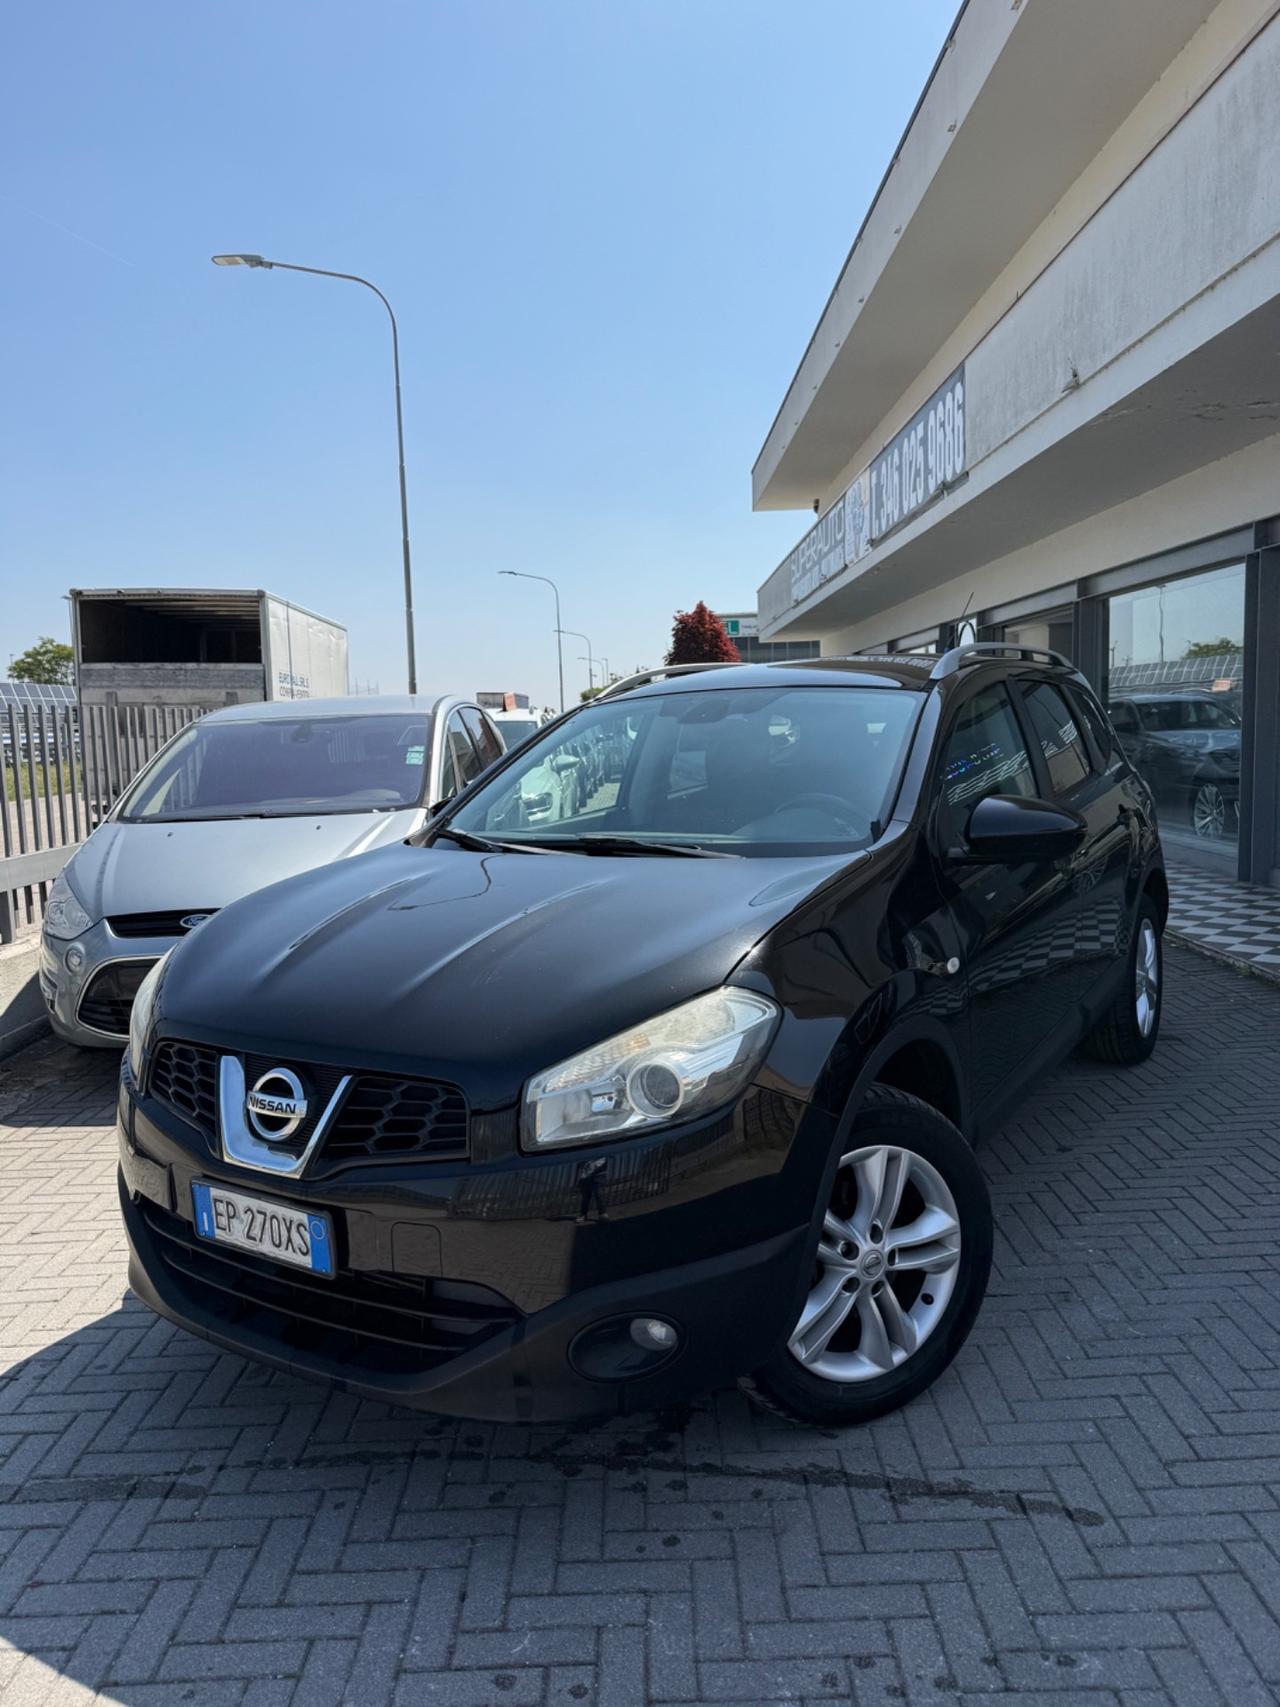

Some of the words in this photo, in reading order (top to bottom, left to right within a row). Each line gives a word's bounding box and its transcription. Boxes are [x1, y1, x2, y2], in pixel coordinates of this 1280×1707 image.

[881, 448, 899, 531] 346
[903, 421, 924, 514] 025
[928, 382, 963, 494] 9686
[250, 1094, 296, 1114] NISSAN
